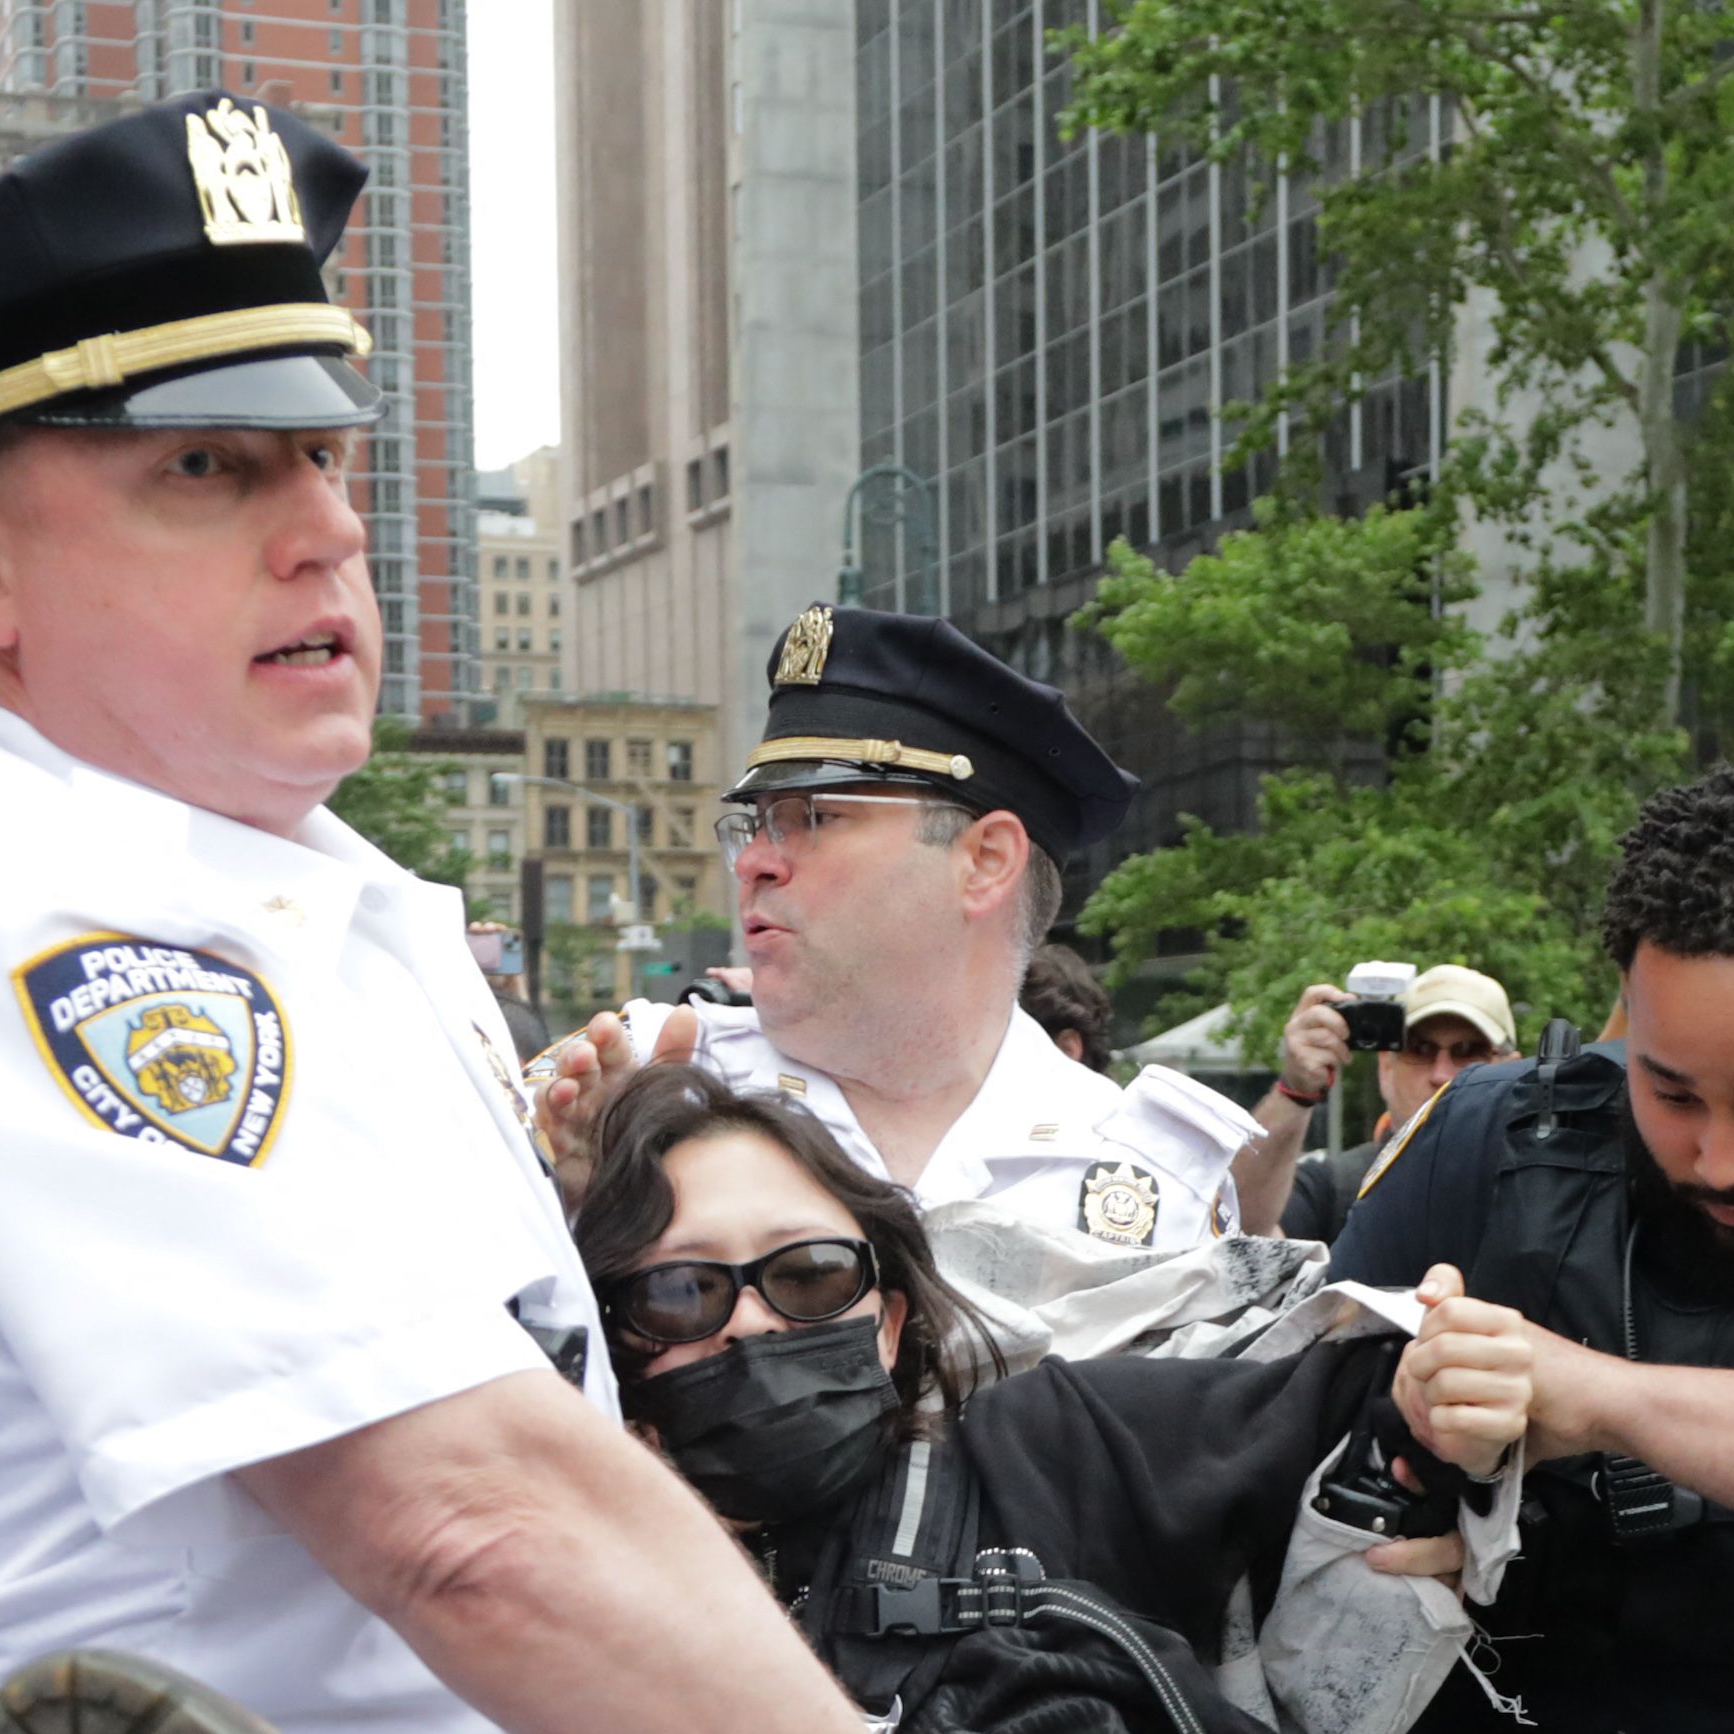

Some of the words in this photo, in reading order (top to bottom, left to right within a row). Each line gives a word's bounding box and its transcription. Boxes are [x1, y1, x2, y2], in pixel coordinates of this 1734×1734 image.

[80, 945, 202, 979] POLICE
[49, 965, 253, 1033] DEPARTMENT
[252, 1010, 285, 1088] YORK
[71, 1063, 143, 1131] CITY
[231, 1089, 276, 1157] NEW
